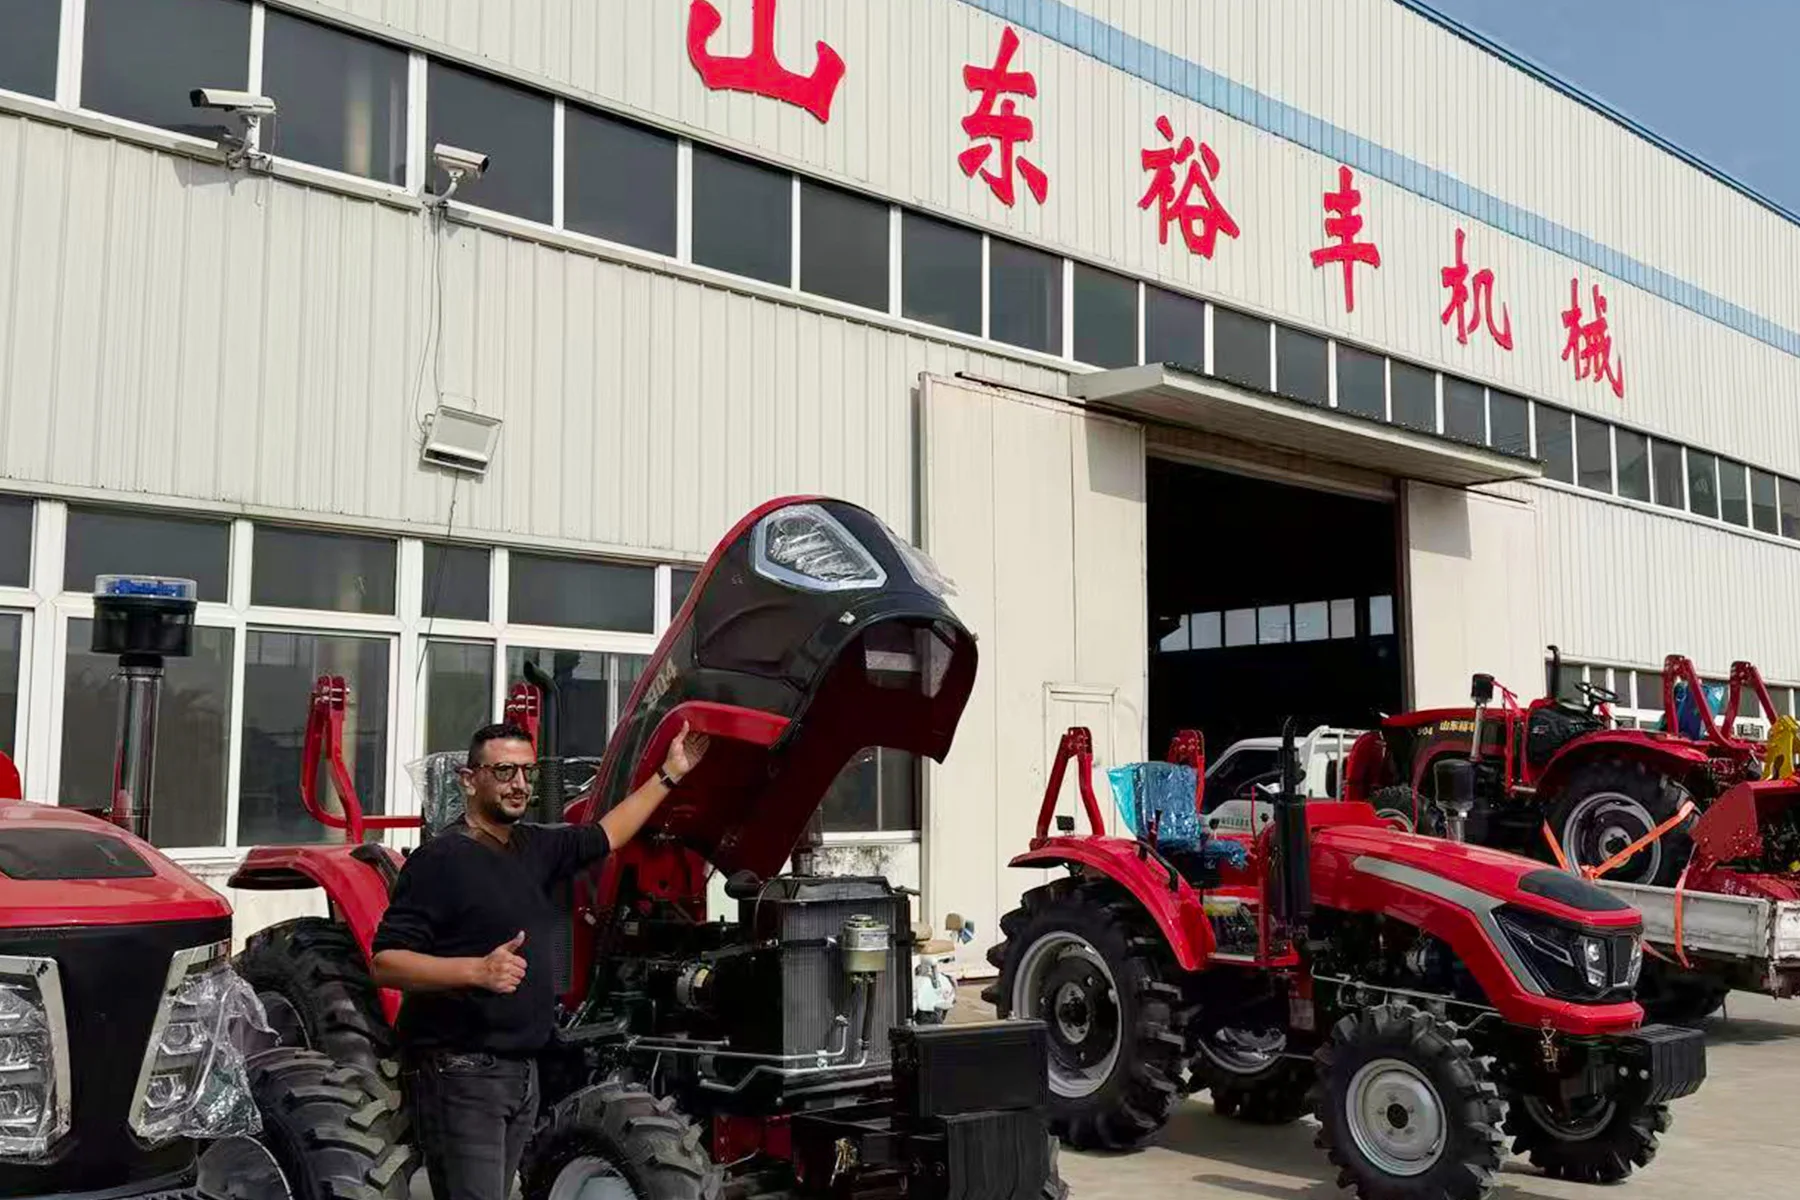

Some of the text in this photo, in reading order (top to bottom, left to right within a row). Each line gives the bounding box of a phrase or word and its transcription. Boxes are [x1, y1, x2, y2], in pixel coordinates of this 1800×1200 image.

[688, 0, 1623, 397] 山东裕丰机械
